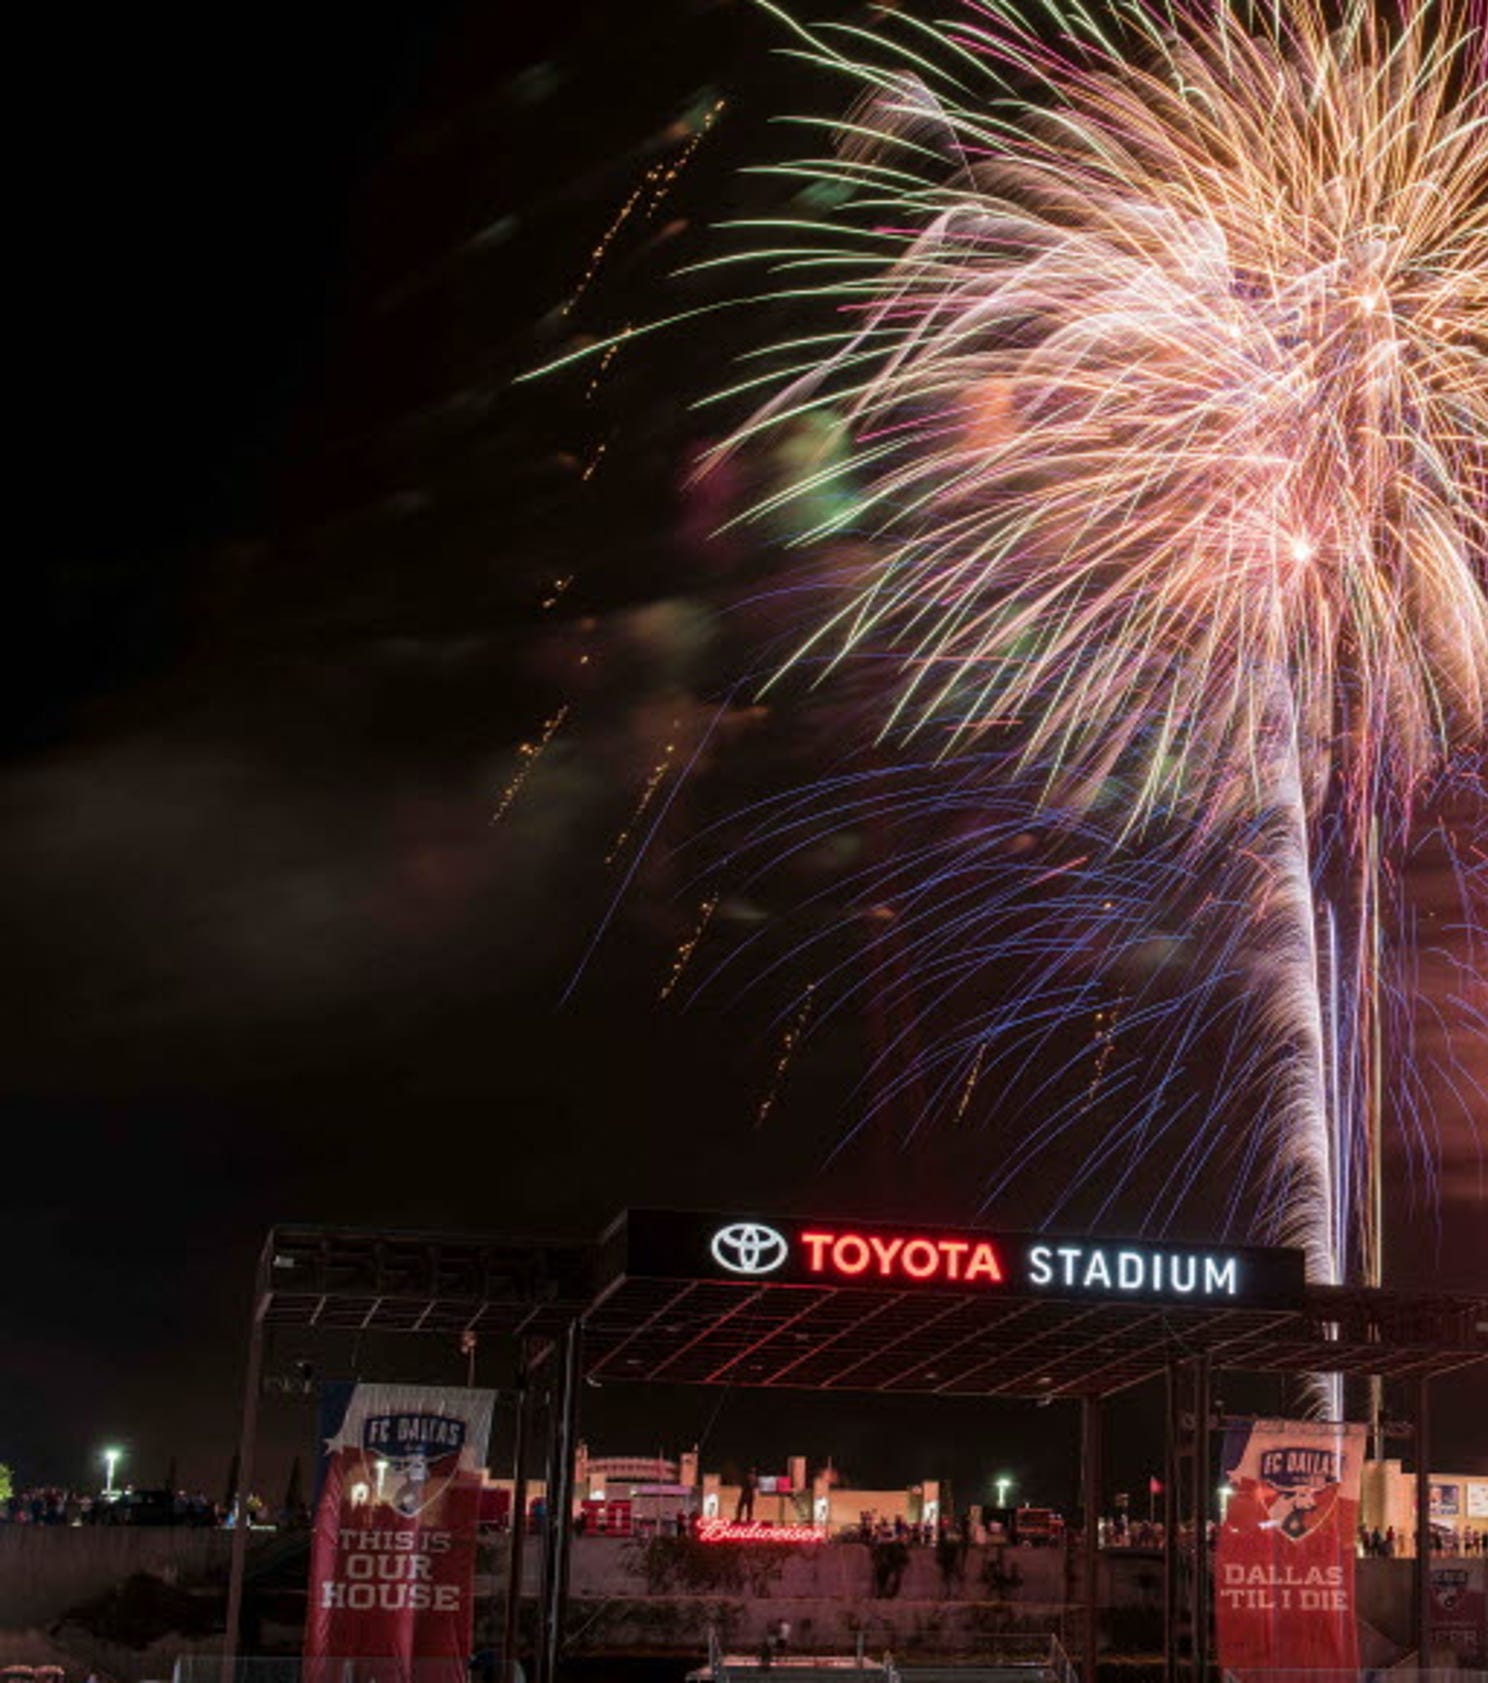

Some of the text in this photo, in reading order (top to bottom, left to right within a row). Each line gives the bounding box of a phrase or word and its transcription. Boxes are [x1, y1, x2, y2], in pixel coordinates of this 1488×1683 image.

[802, 1232, 1237, 1295] TOYOTA STADIUM
[368, 1418, 461, 1446] FC DALLAS
[1264, 1451, 1343, 1477] FC DALLAS
[340, 1529, 451, 1553] THIS IS
[695, 1516, 826, 1541] Budweiser
[345, 1553, 433, 1580] OUR
[1225, 1563, 1344, 1586] DALLAS
[322, 1580, 461, 1612] HOUSE
[1220, 1588, 1348, 1612] 'TIL I DIE
